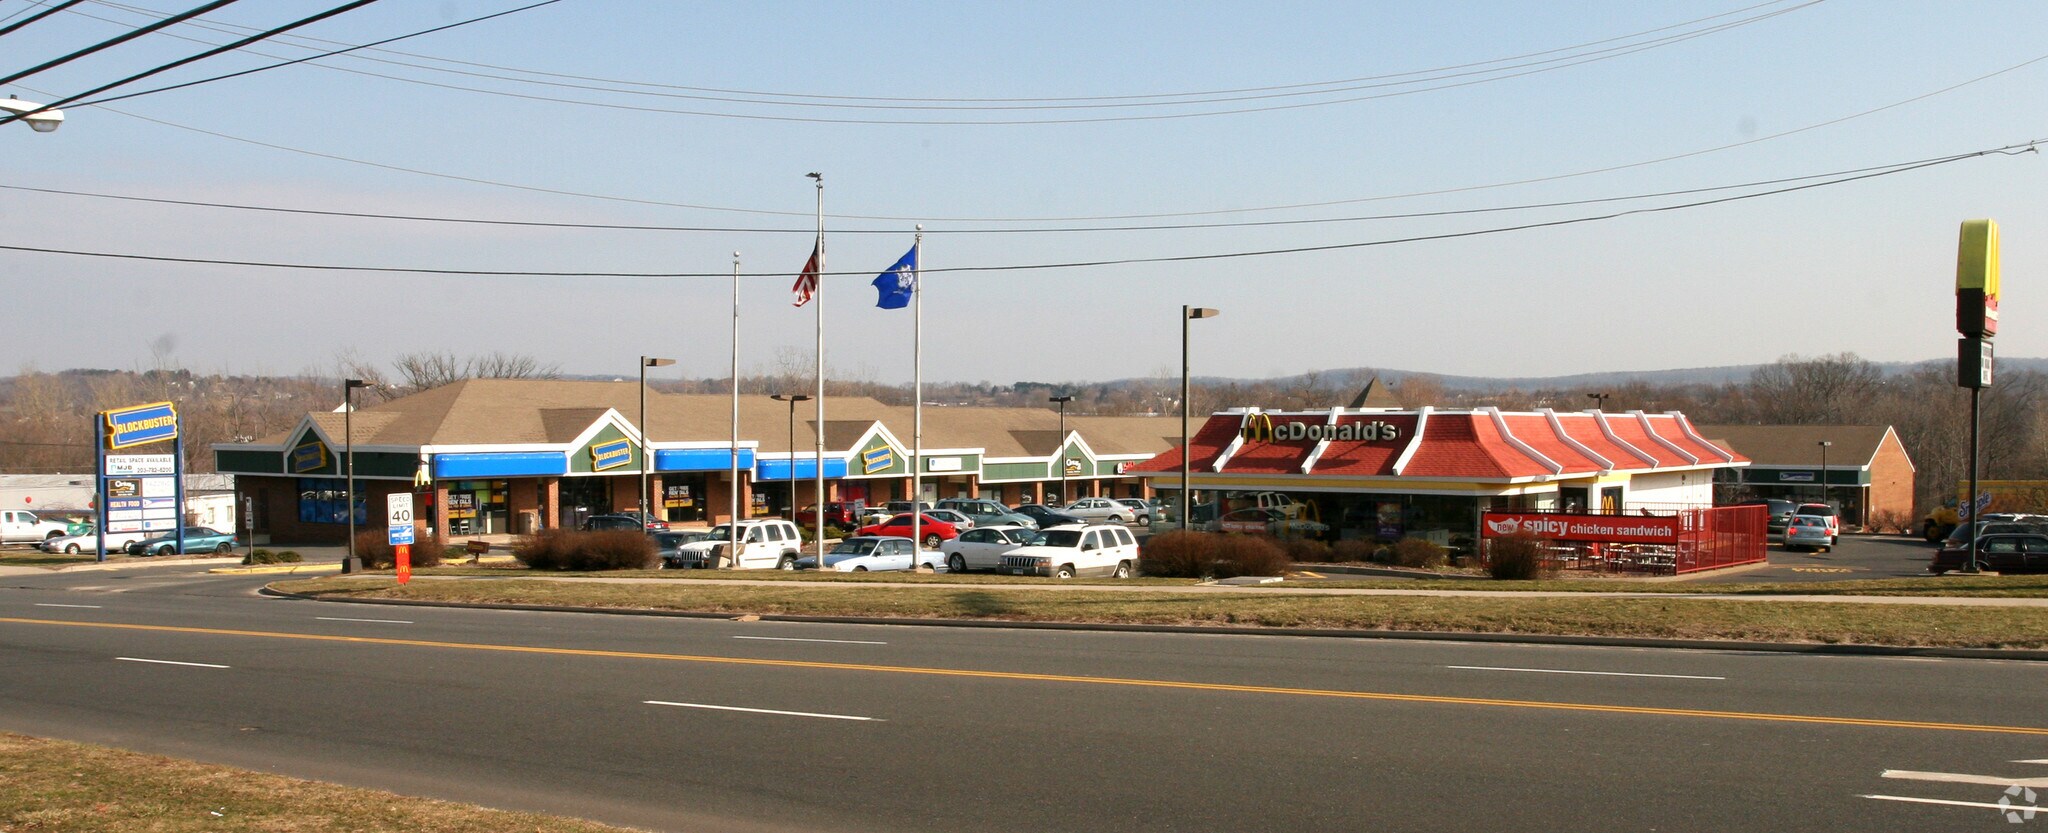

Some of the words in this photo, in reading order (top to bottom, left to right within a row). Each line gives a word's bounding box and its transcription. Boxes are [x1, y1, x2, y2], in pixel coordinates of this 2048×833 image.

[118, 416, 173, 433] BLOCKBUSTER
[1243, 412, 1397, 444] McDonald's
[392, 510, 410, 521] 40
[1497, 523, 1513, 531] new
[1523, 517, 1568, 536] spicy
[1570, 523, 1614, 535] chicken
[1616, 525, 1672, 537] sandwich
